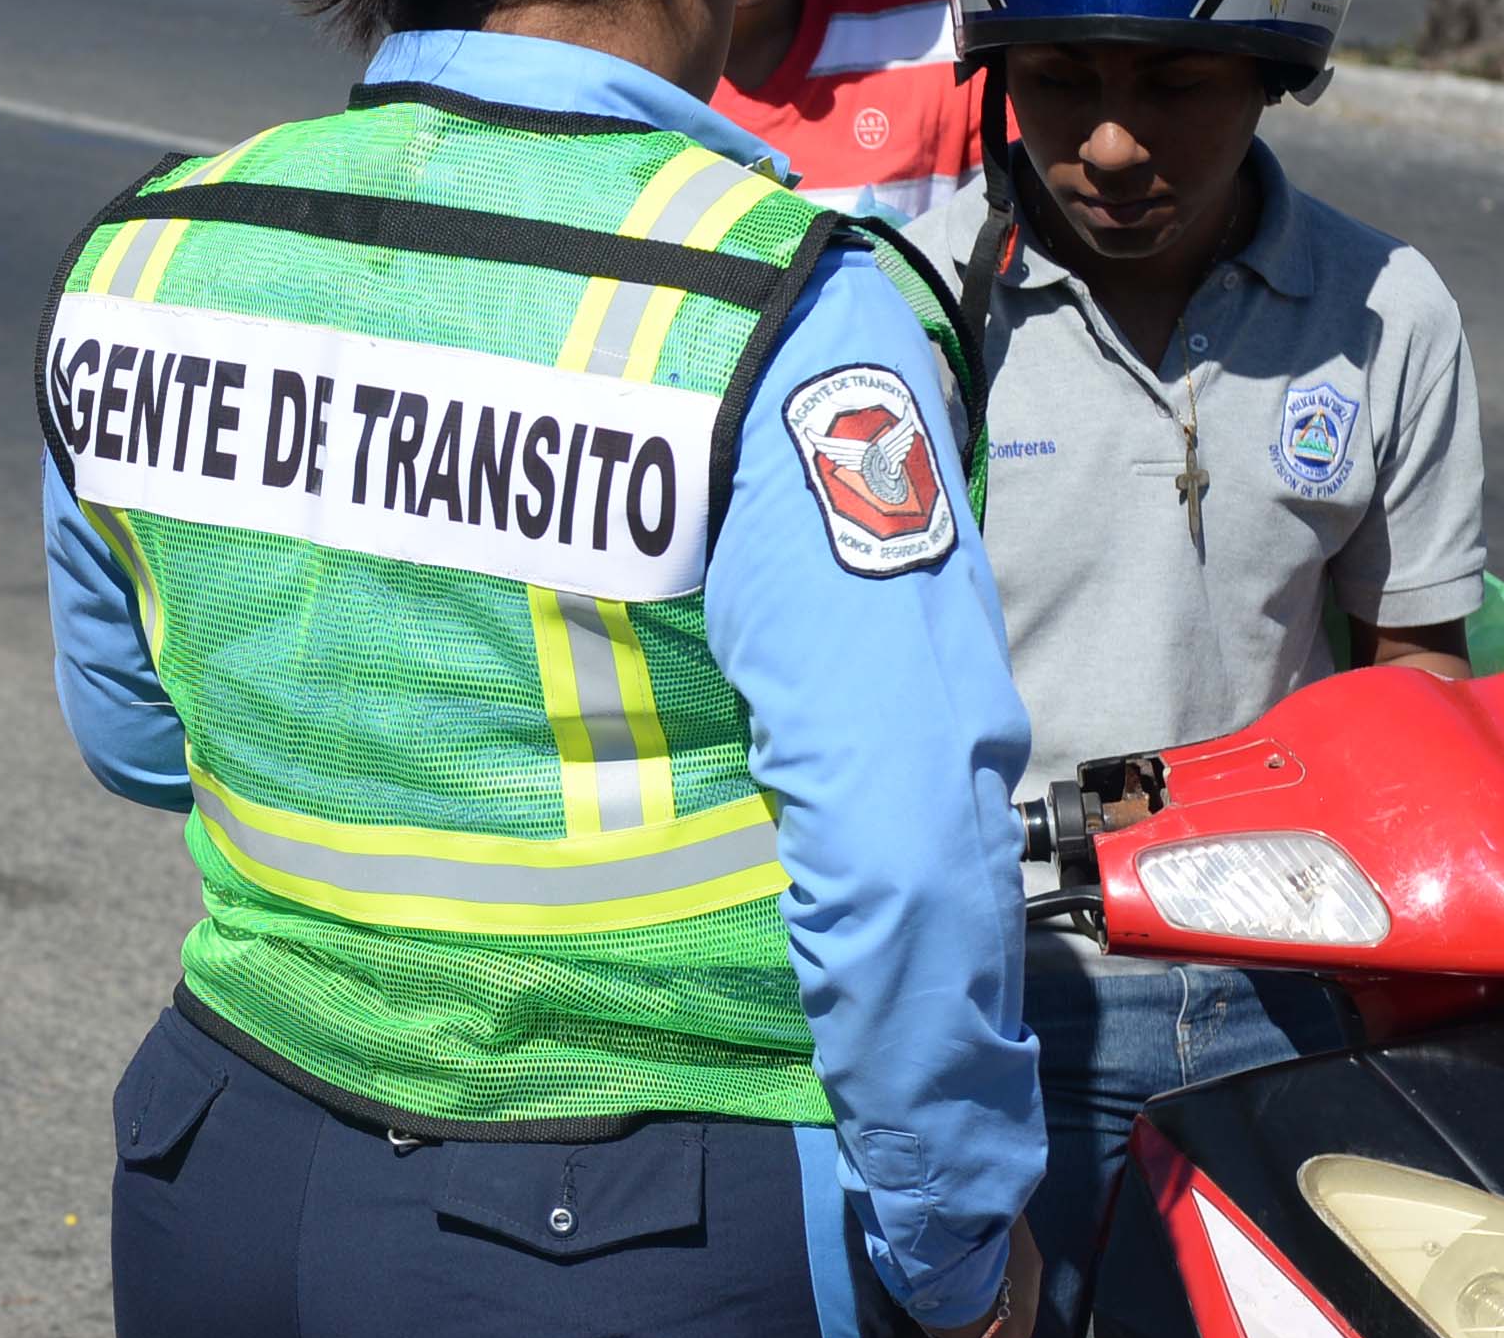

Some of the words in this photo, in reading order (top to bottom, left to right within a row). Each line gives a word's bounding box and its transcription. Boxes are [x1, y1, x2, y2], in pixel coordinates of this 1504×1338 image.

[790, 383, 834, 429] AGENTE
[832, 376, 850, 392] DE
[849, 374, 912, 406] TRANSITO
[51, 337, 246, 481] AGENTE
[262, 367, 334, 497] DE
[350, 383, 678, 559] TRANSITO
[987, 440, 1056, 460] Contreras
[1300, 484, 1313, 498] DE
[837, 531, 873, 556] HONOR
